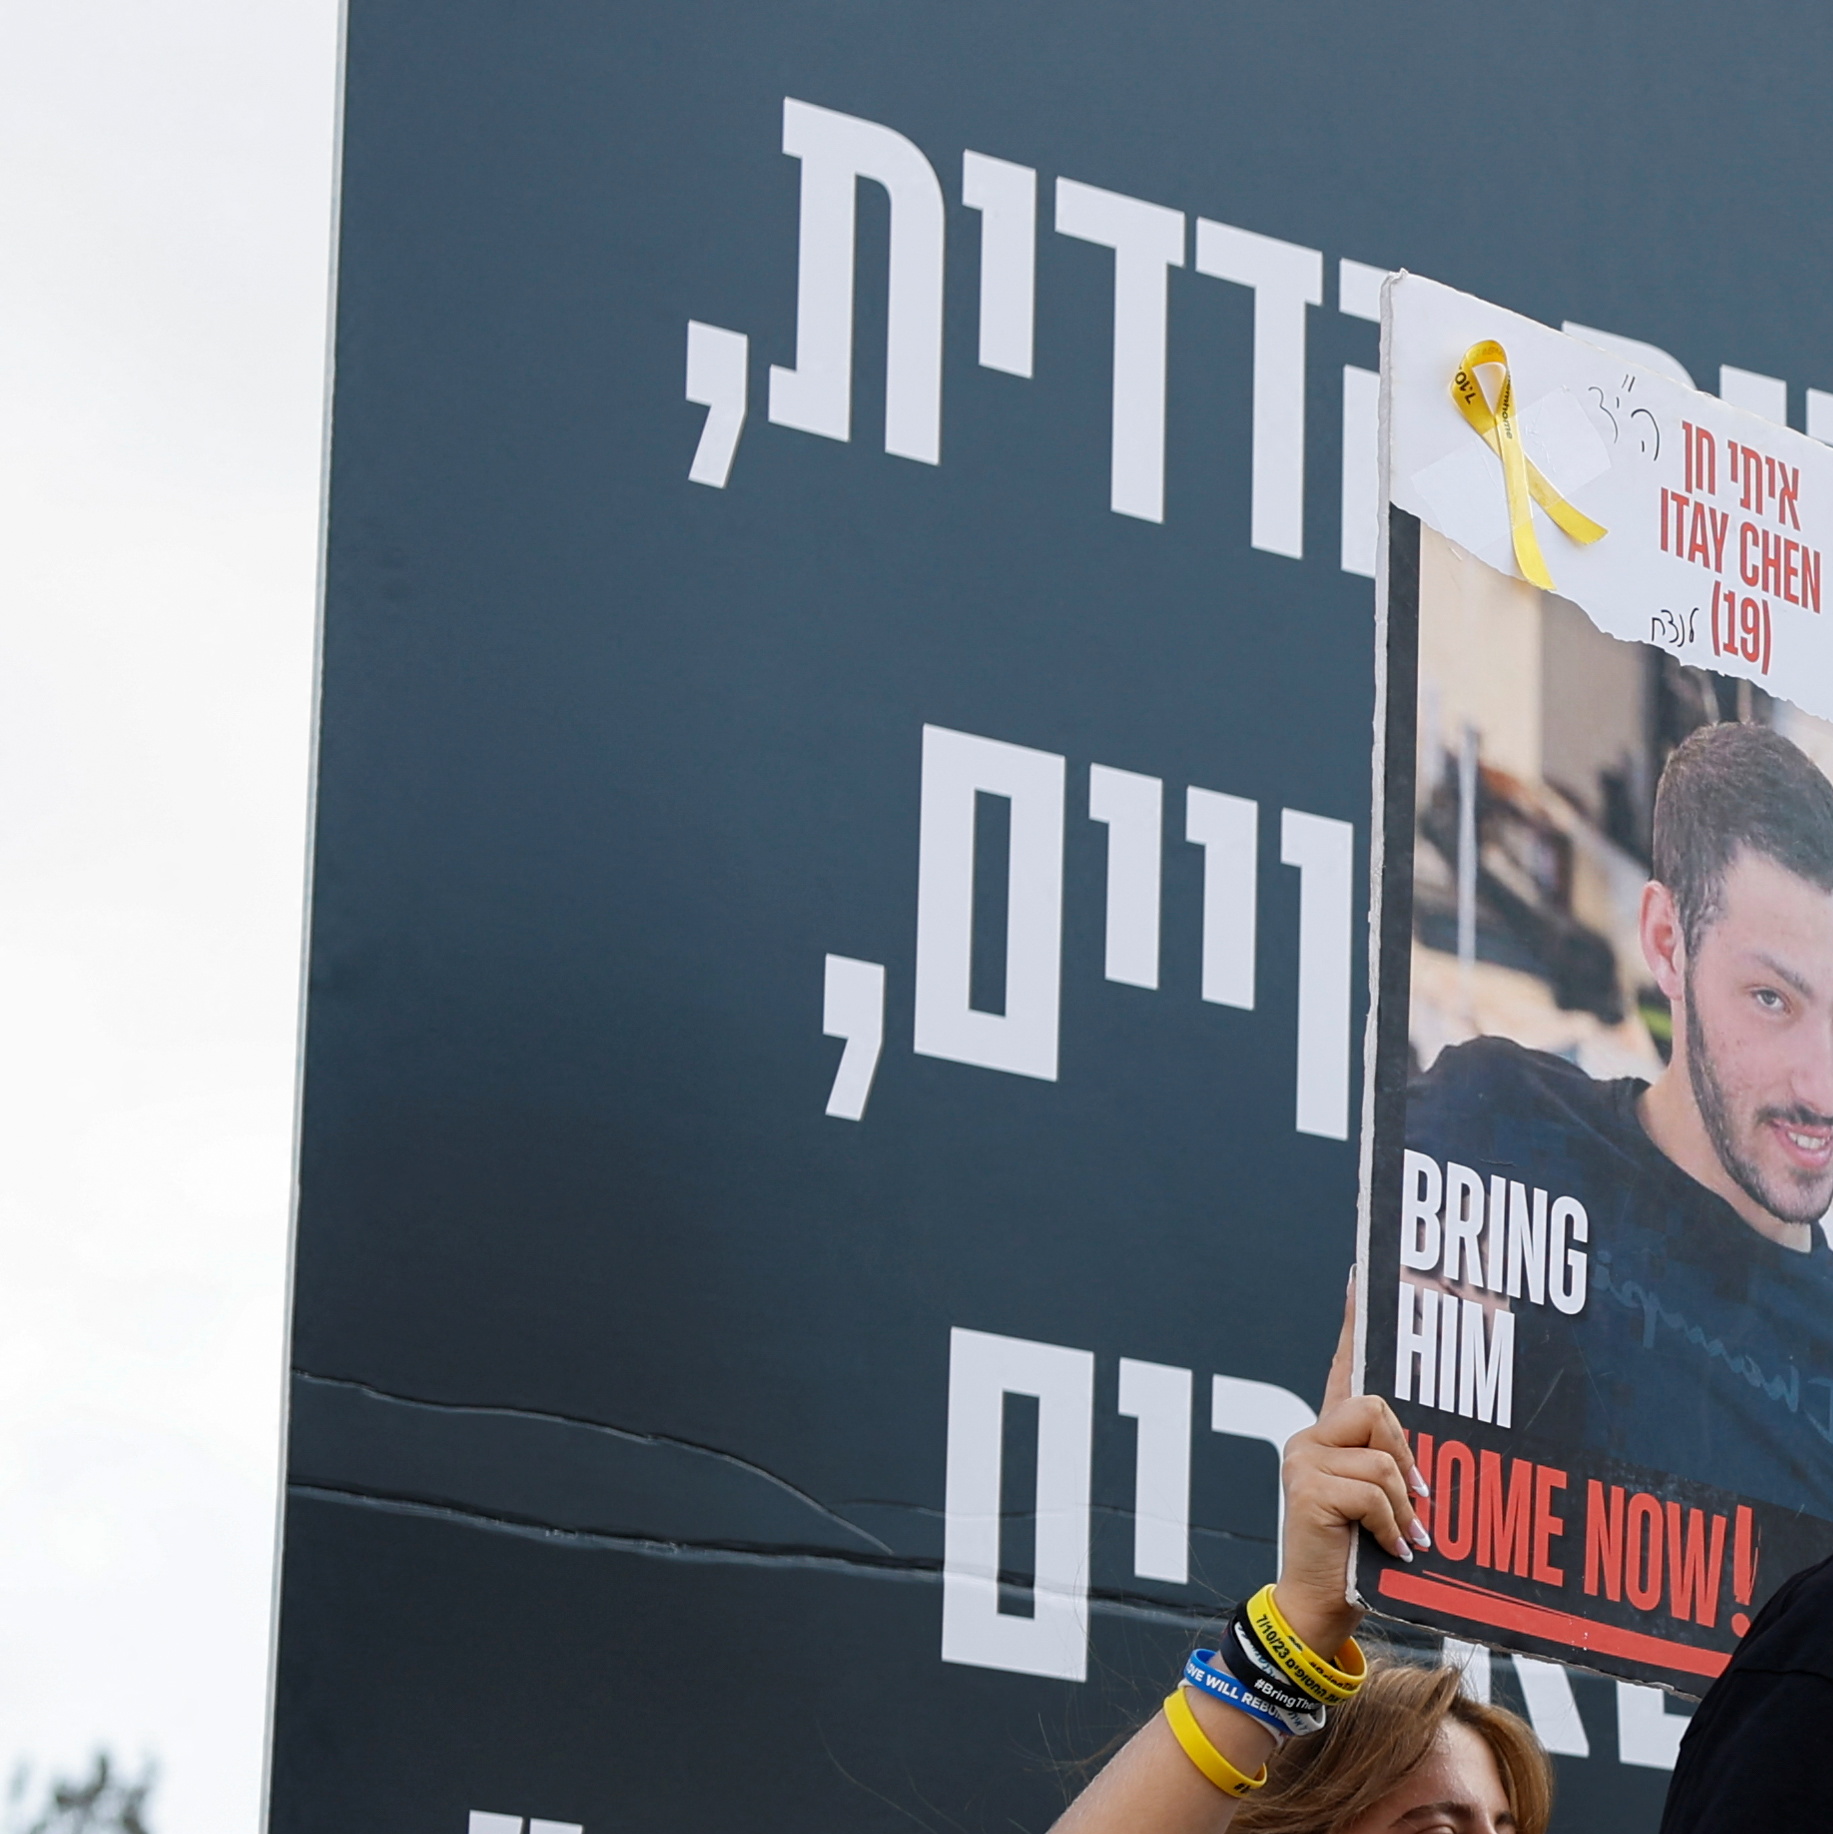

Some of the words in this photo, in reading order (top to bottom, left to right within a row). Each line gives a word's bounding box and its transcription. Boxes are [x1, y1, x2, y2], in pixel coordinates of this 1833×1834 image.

[1682, 420, 1716, 495] חן
[1727, 439, 1801, 531] איתי
[1660, 487, 1729, 574] ITAY
[1740, 522, 1821, 614] CHEN
[1711, 580, 1772, 675] (19)
[1400, 1149, 1589, 1315] BRING
[1394, 1283, 1516, 1429] HIM
[1584, 1478, 1757, 1638] NOW!
[1256, 1614, 1290, 1659] 7/10/23
[1206, 1674, 1239, 1700] WILL
